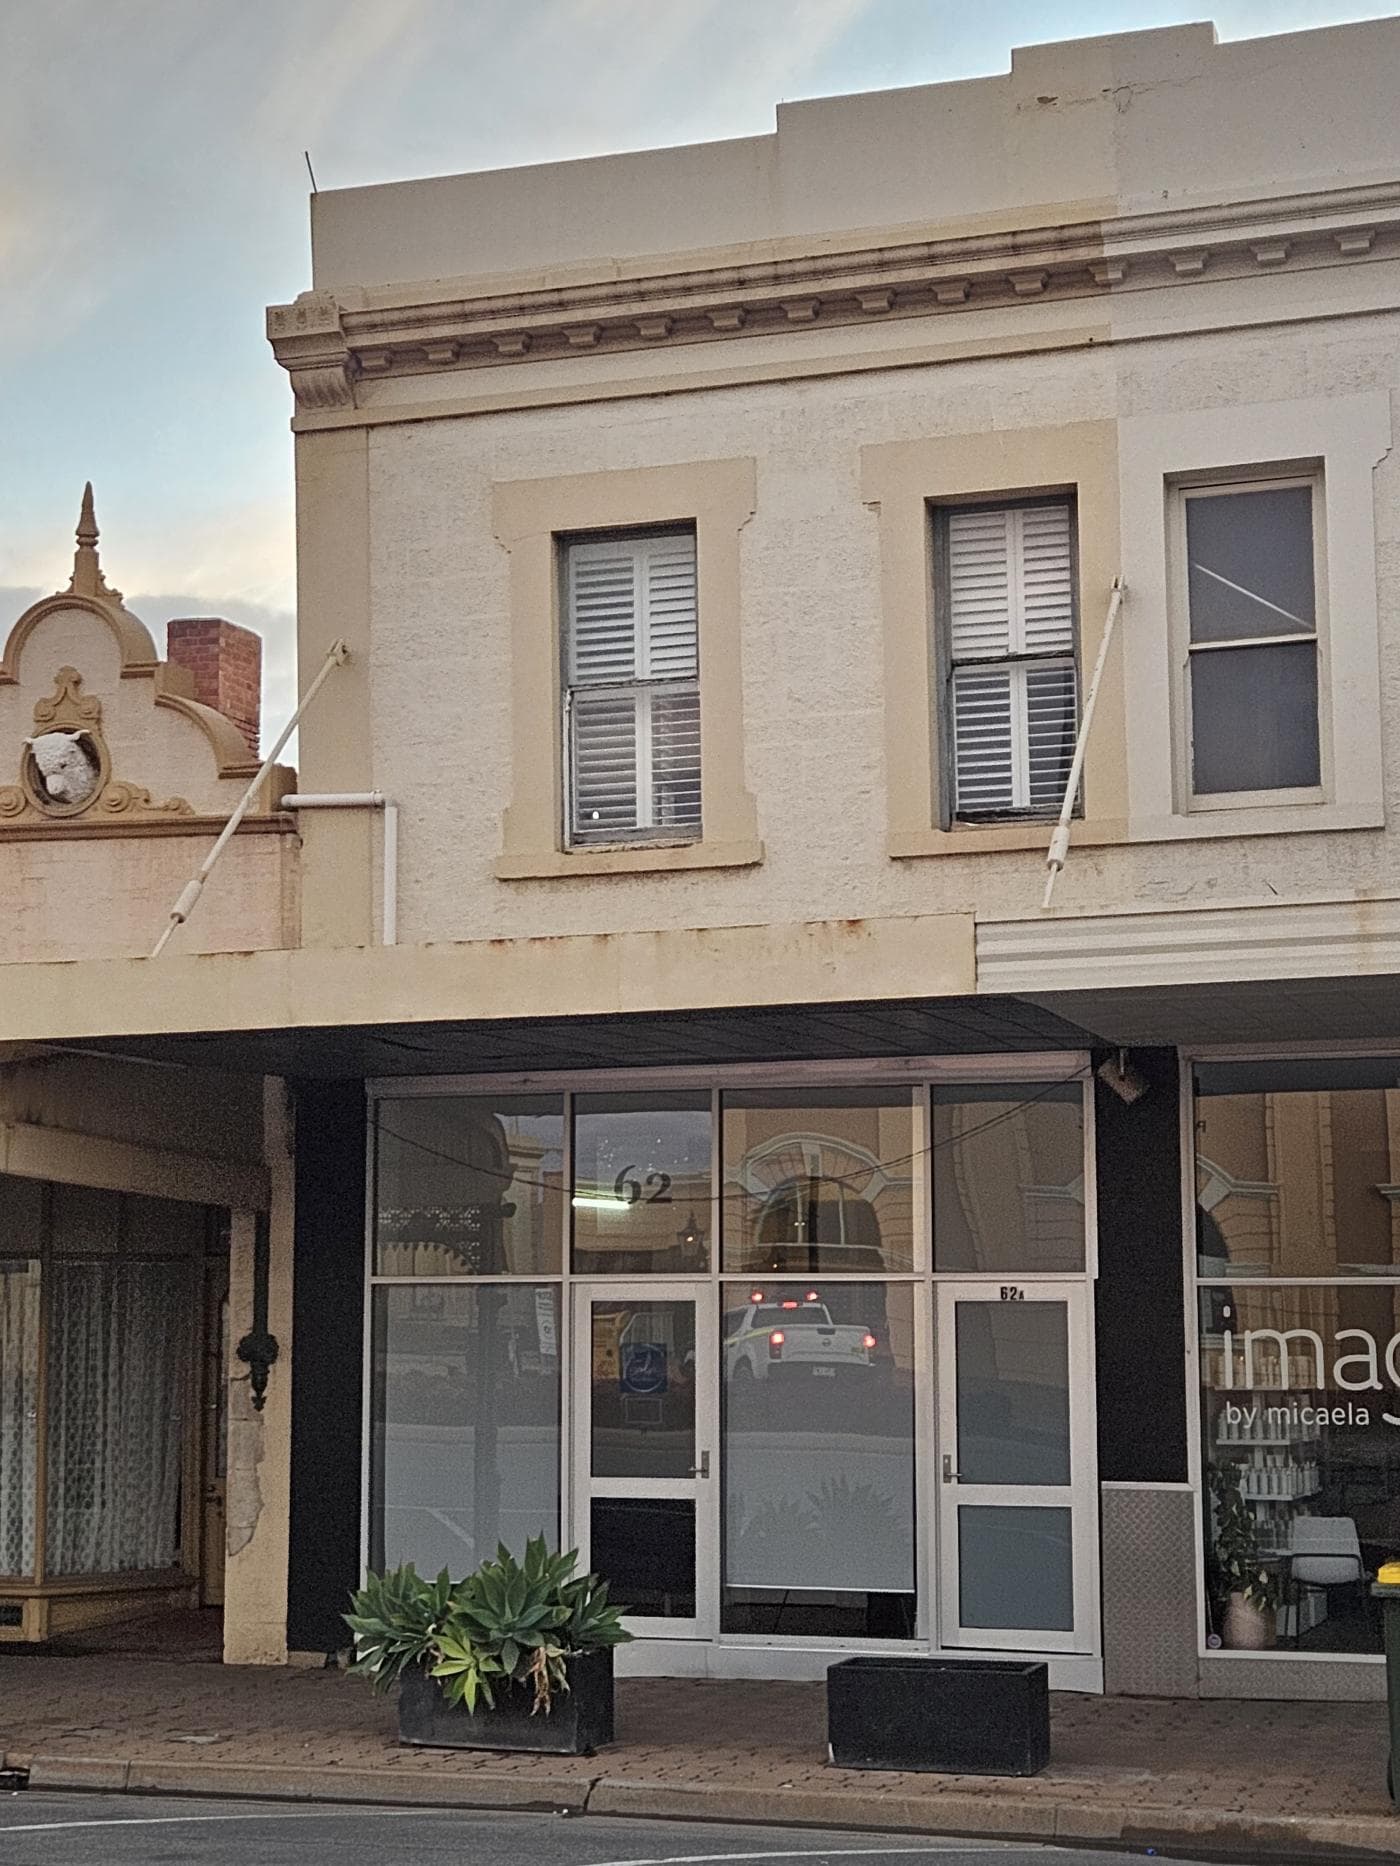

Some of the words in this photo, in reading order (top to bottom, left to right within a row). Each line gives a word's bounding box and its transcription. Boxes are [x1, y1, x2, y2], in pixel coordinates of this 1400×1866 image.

[614, 1164, 673, 1205] 62
[1226, 1401, 1257, 1429] by
[1268, 1402, 1370, 1425] micaela
